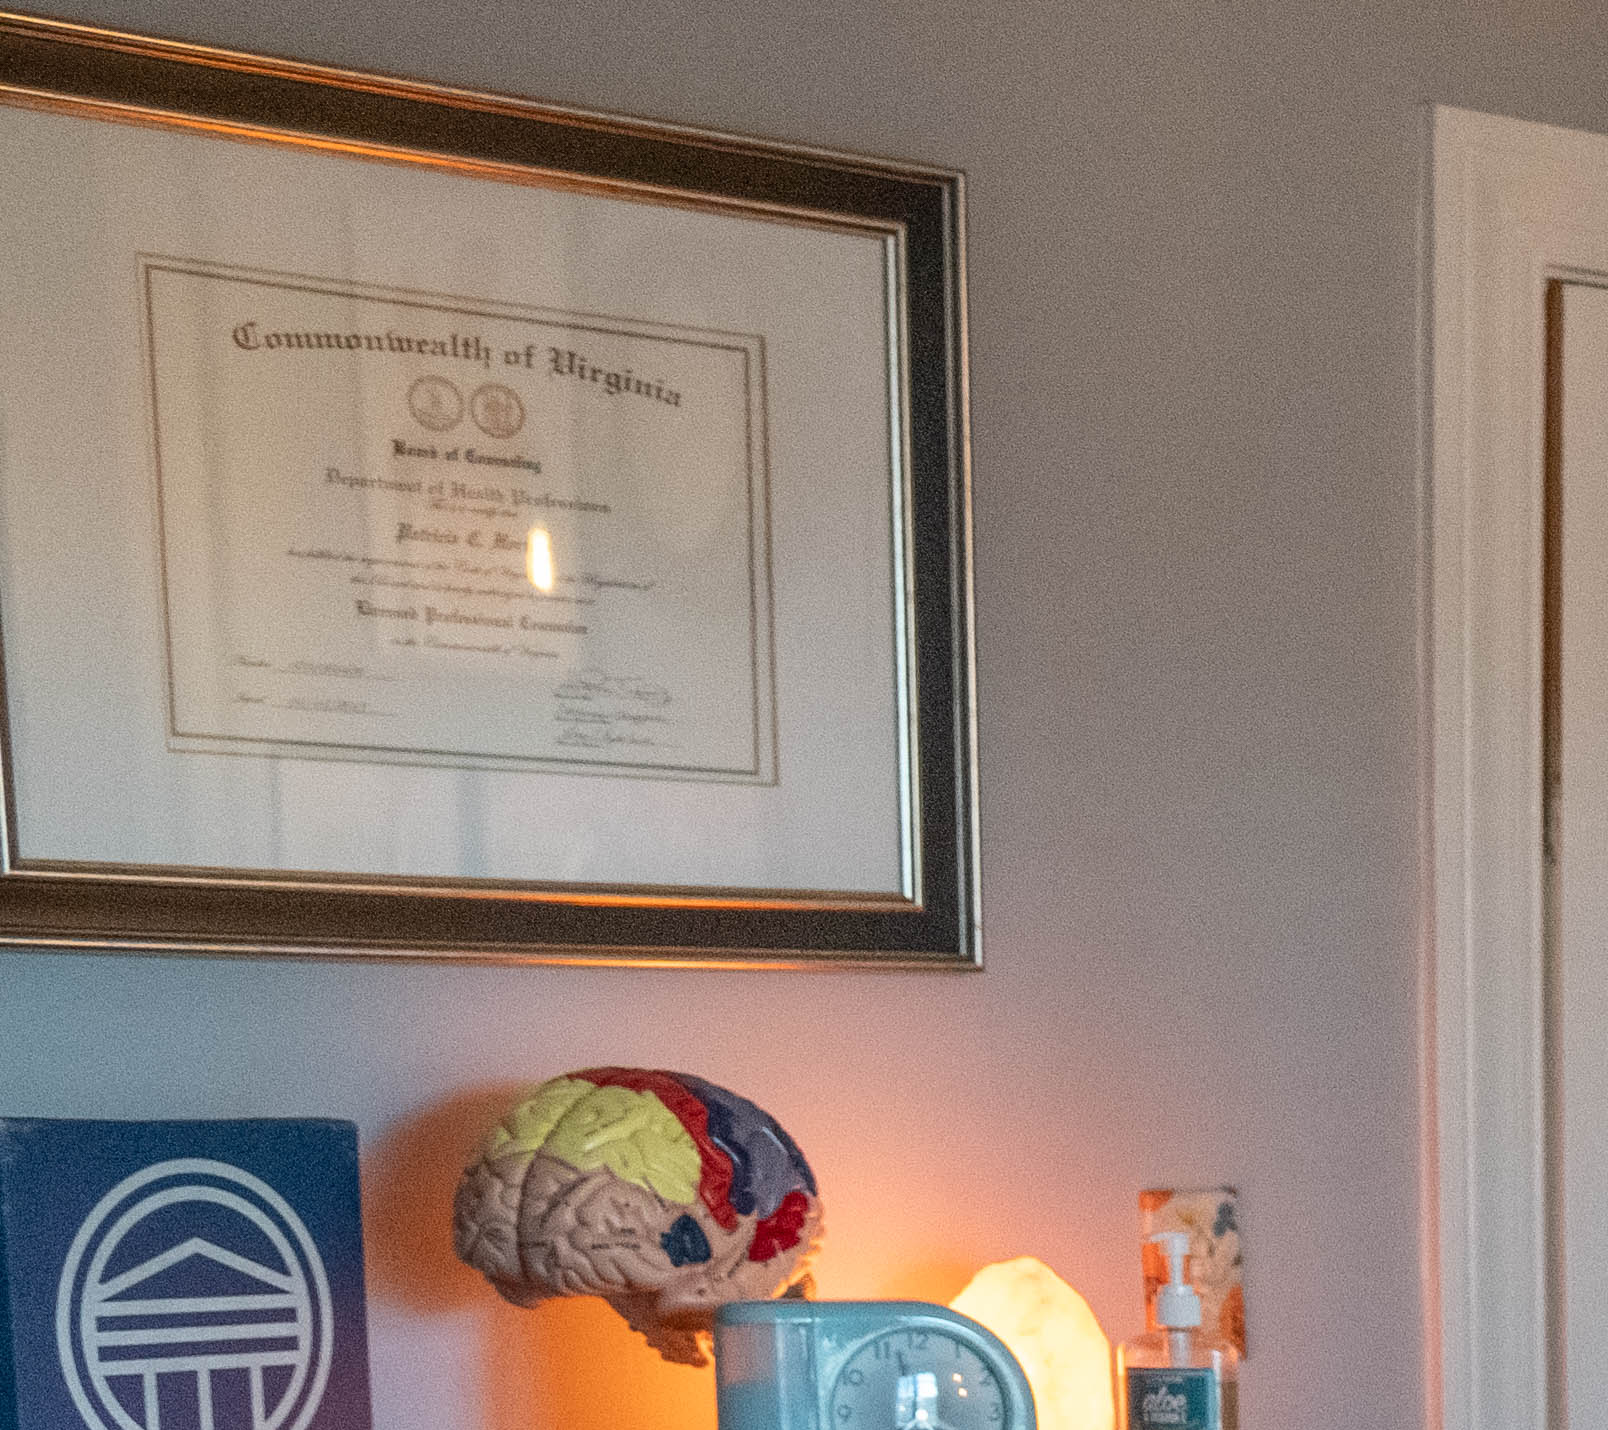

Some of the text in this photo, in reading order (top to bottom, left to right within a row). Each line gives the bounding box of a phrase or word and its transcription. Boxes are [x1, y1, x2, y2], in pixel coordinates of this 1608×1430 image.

[233, 321, 682, 408] Commonwealth of Virginia
[873, 1340, 890, 1359] 11
[905, 1333, 929, 1348] 12
[954, 1343, 962, 1358] 1
[842, 1369, 863, 1386] 10
[837, 1405, 851, 1424] 9
[988, 1403, 1000, 1422] 3
